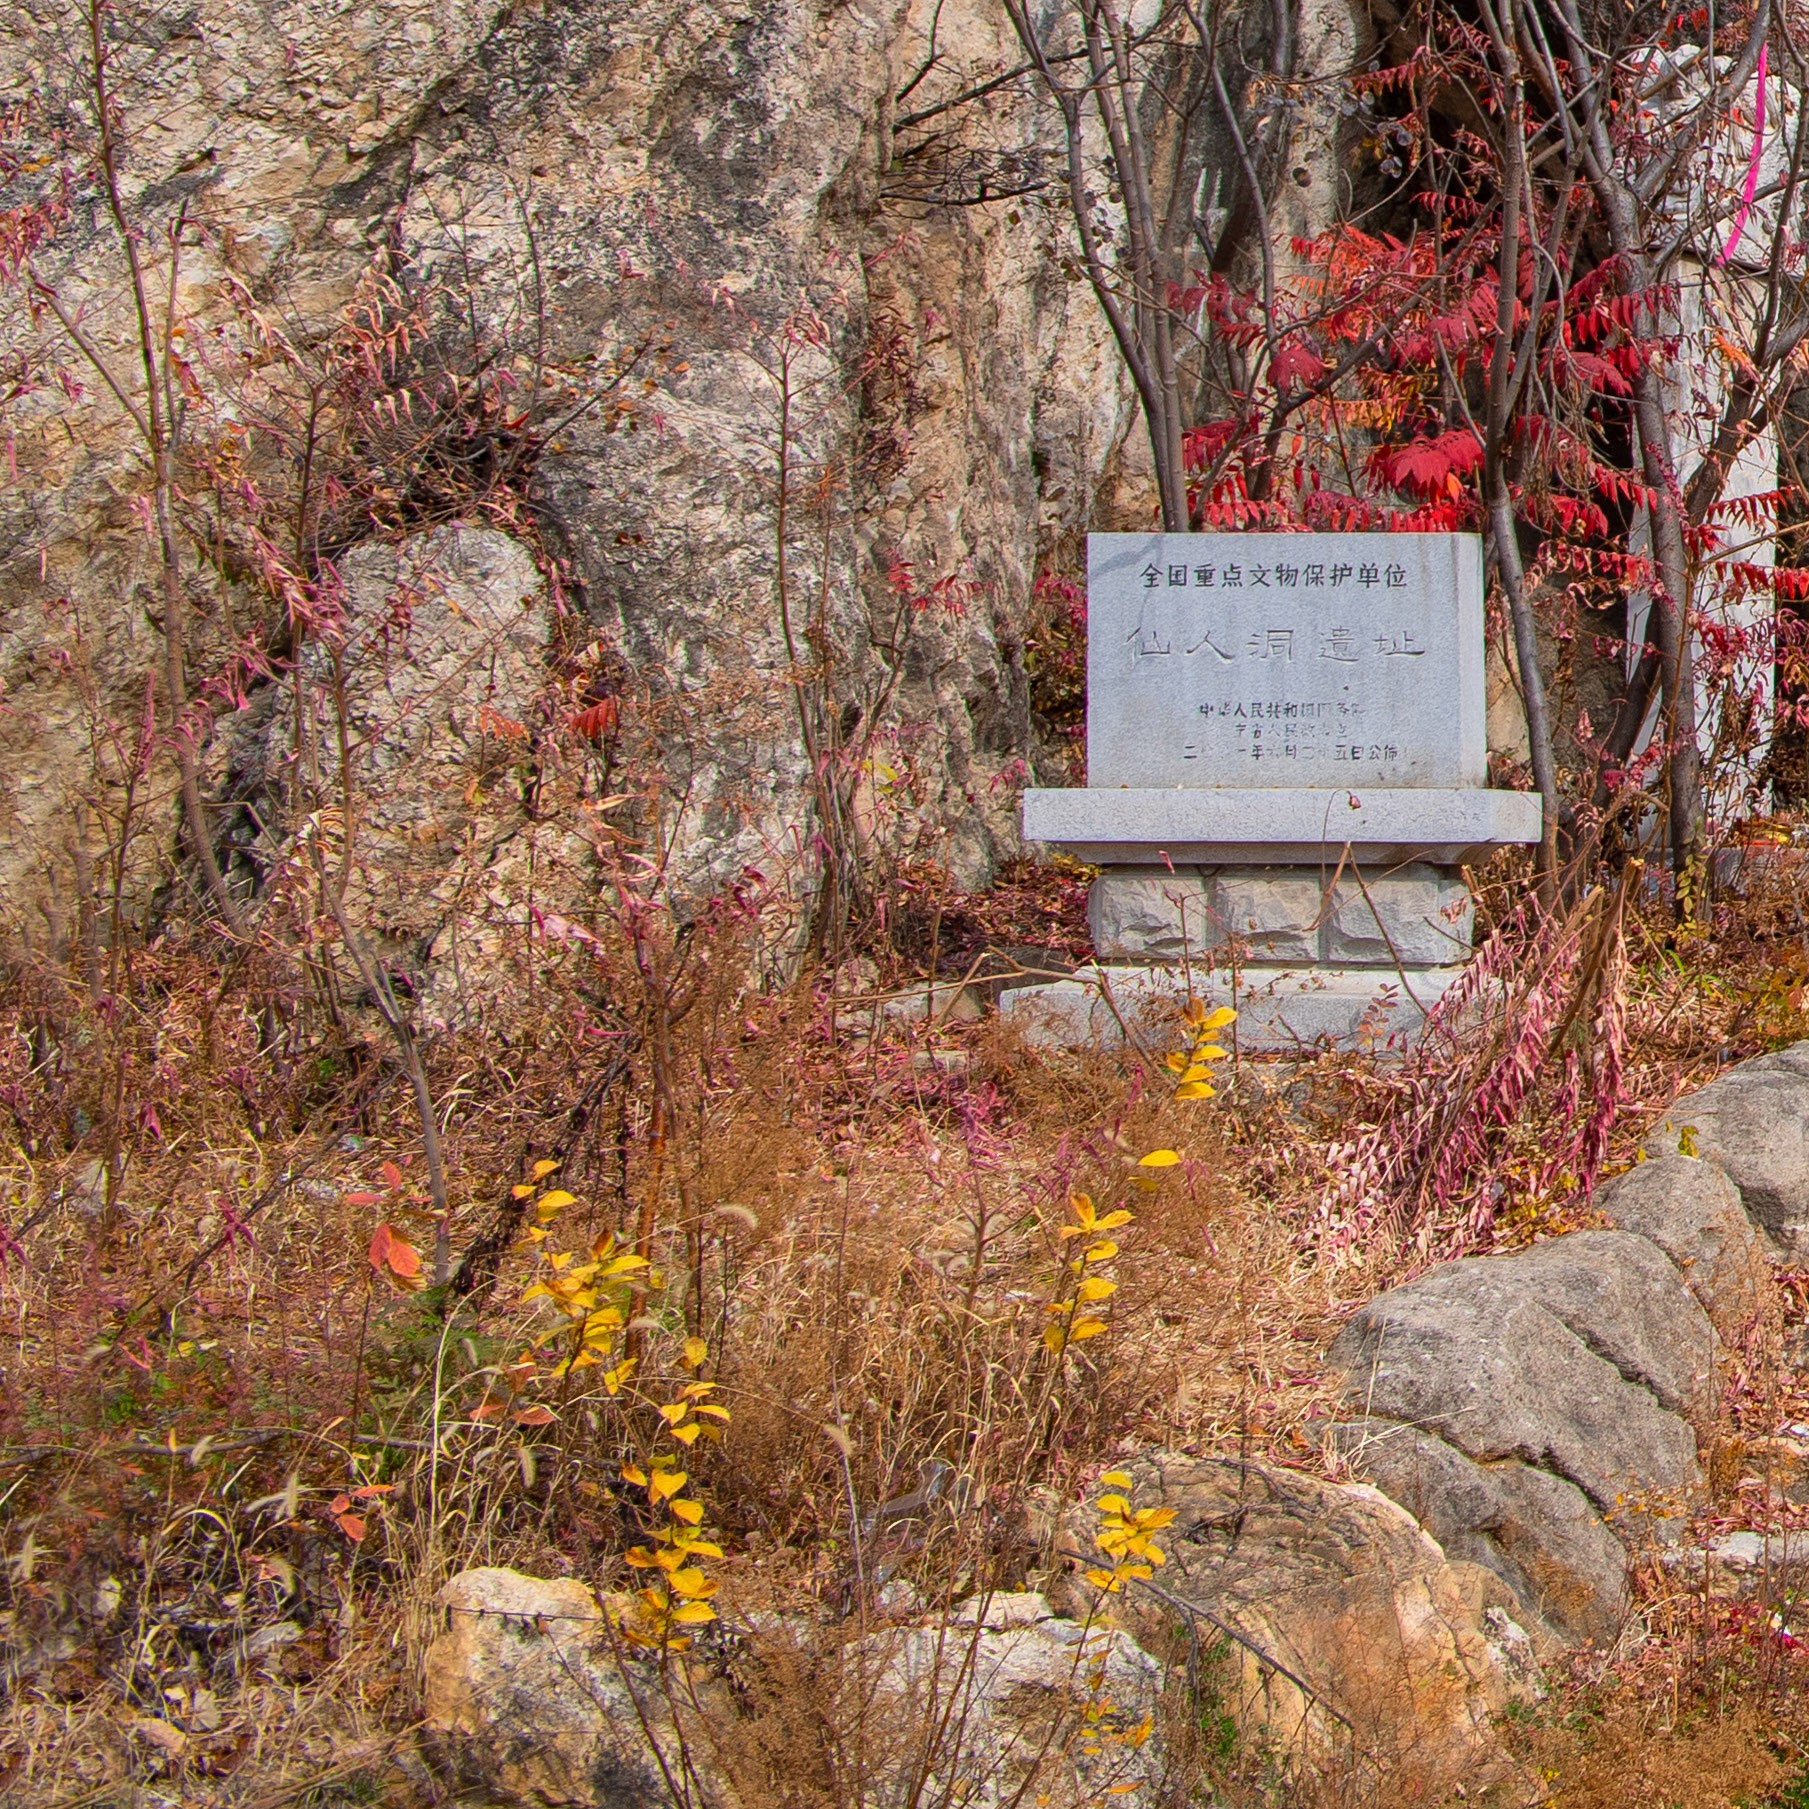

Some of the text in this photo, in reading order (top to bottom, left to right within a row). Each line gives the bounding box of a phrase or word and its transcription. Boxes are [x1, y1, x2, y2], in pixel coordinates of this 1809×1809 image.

[1139, 562, 1408, 589] 全国重点文物保护单位
